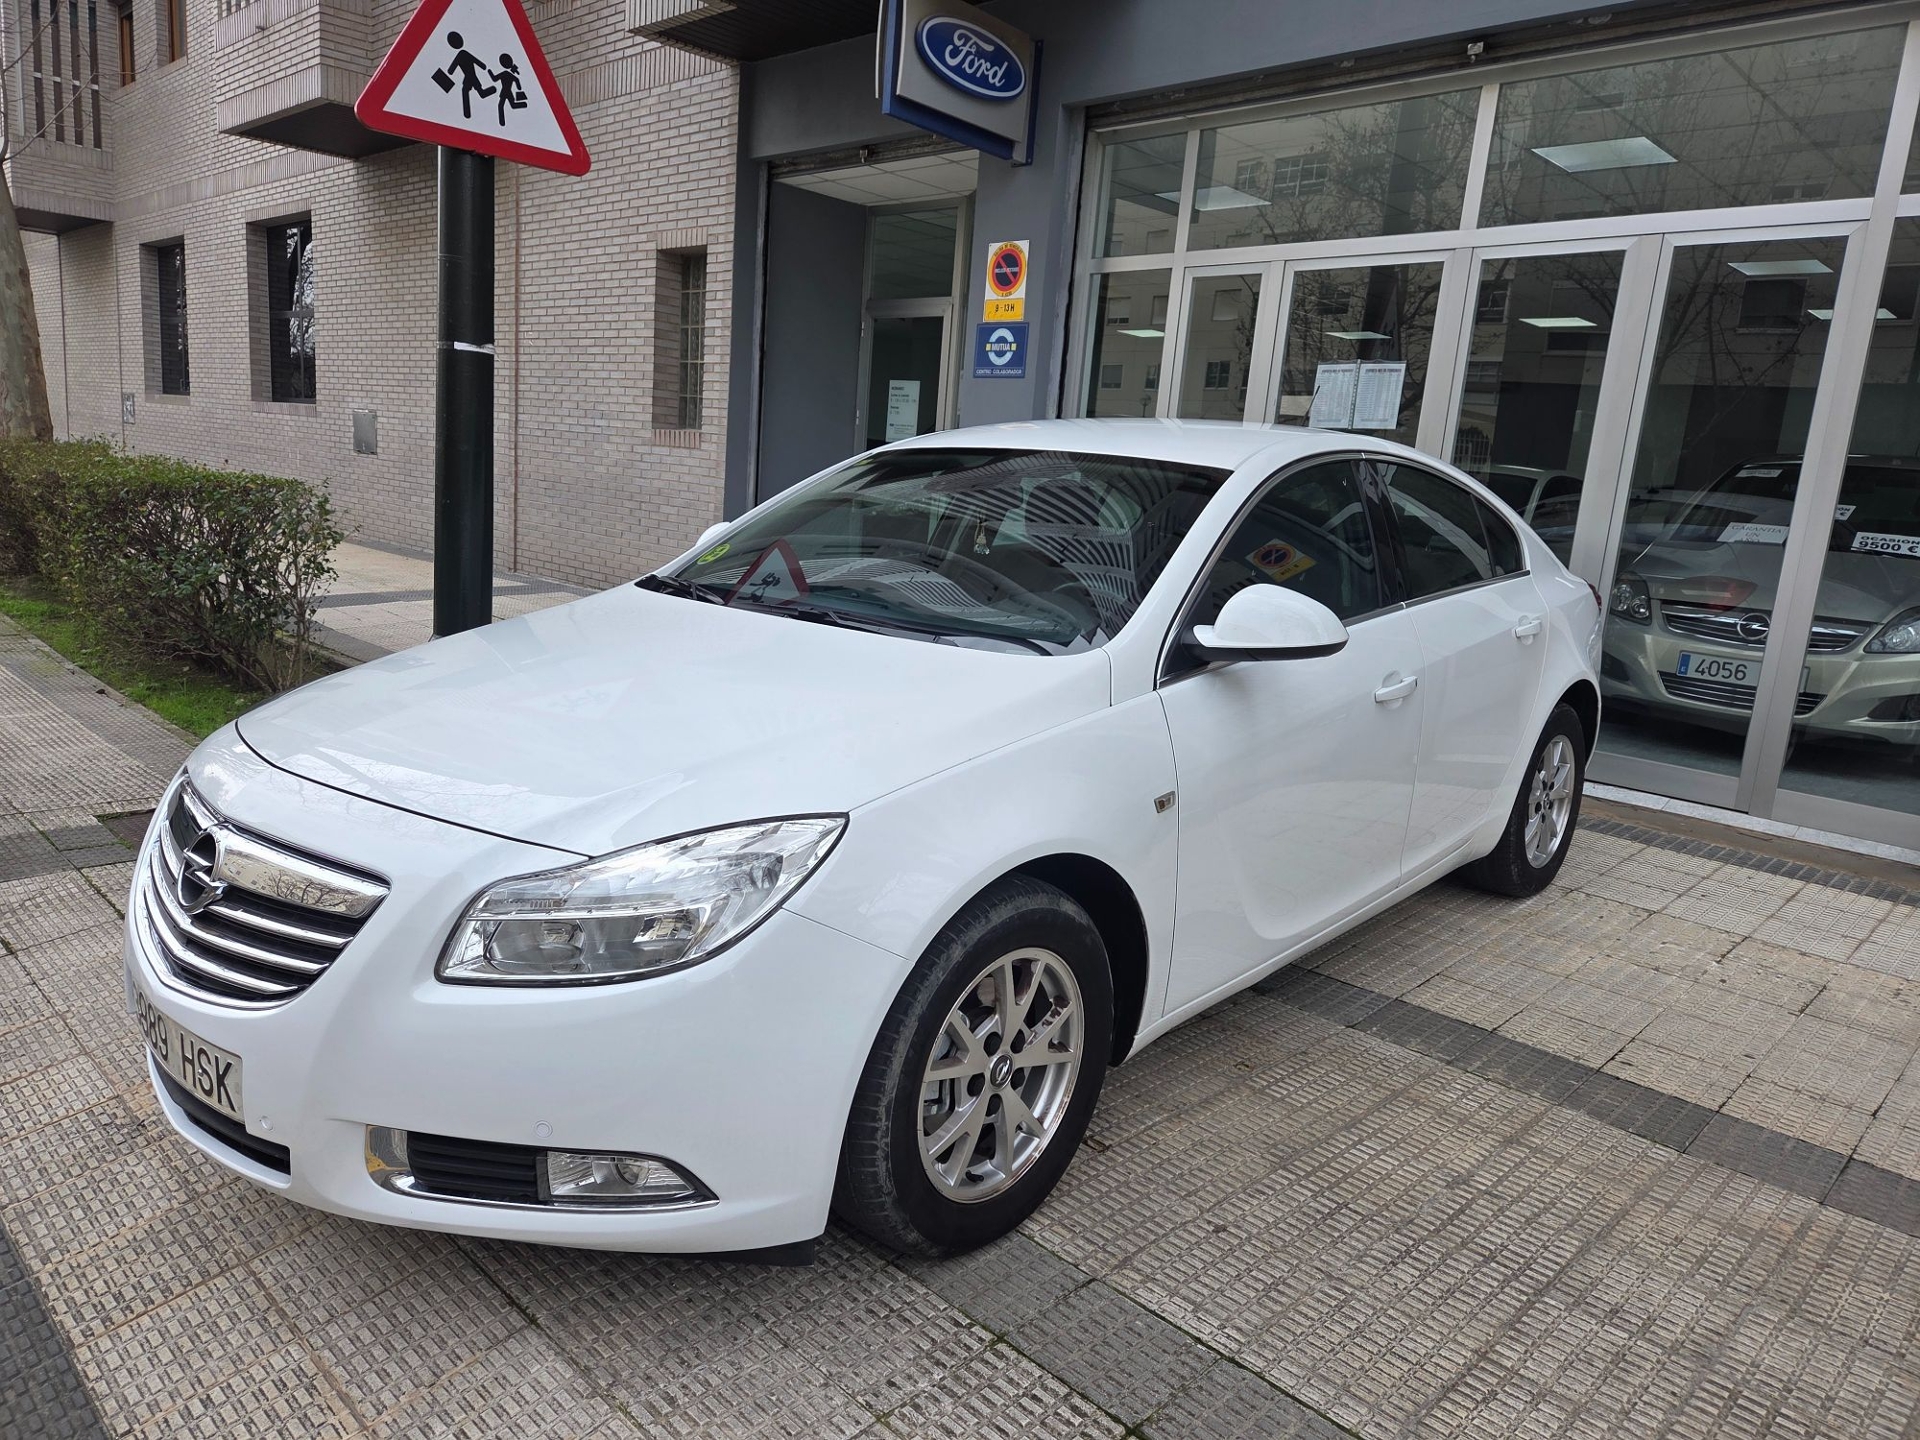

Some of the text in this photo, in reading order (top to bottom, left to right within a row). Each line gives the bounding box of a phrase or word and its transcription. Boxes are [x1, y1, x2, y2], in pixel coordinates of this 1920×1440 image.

[944, 28, 1008, 88] Ford
[1858, 540, 1919, 554] 9500 €
[1694, 658, 1748, 681] 4056
[180, 1032, 237, 1113] HSK
